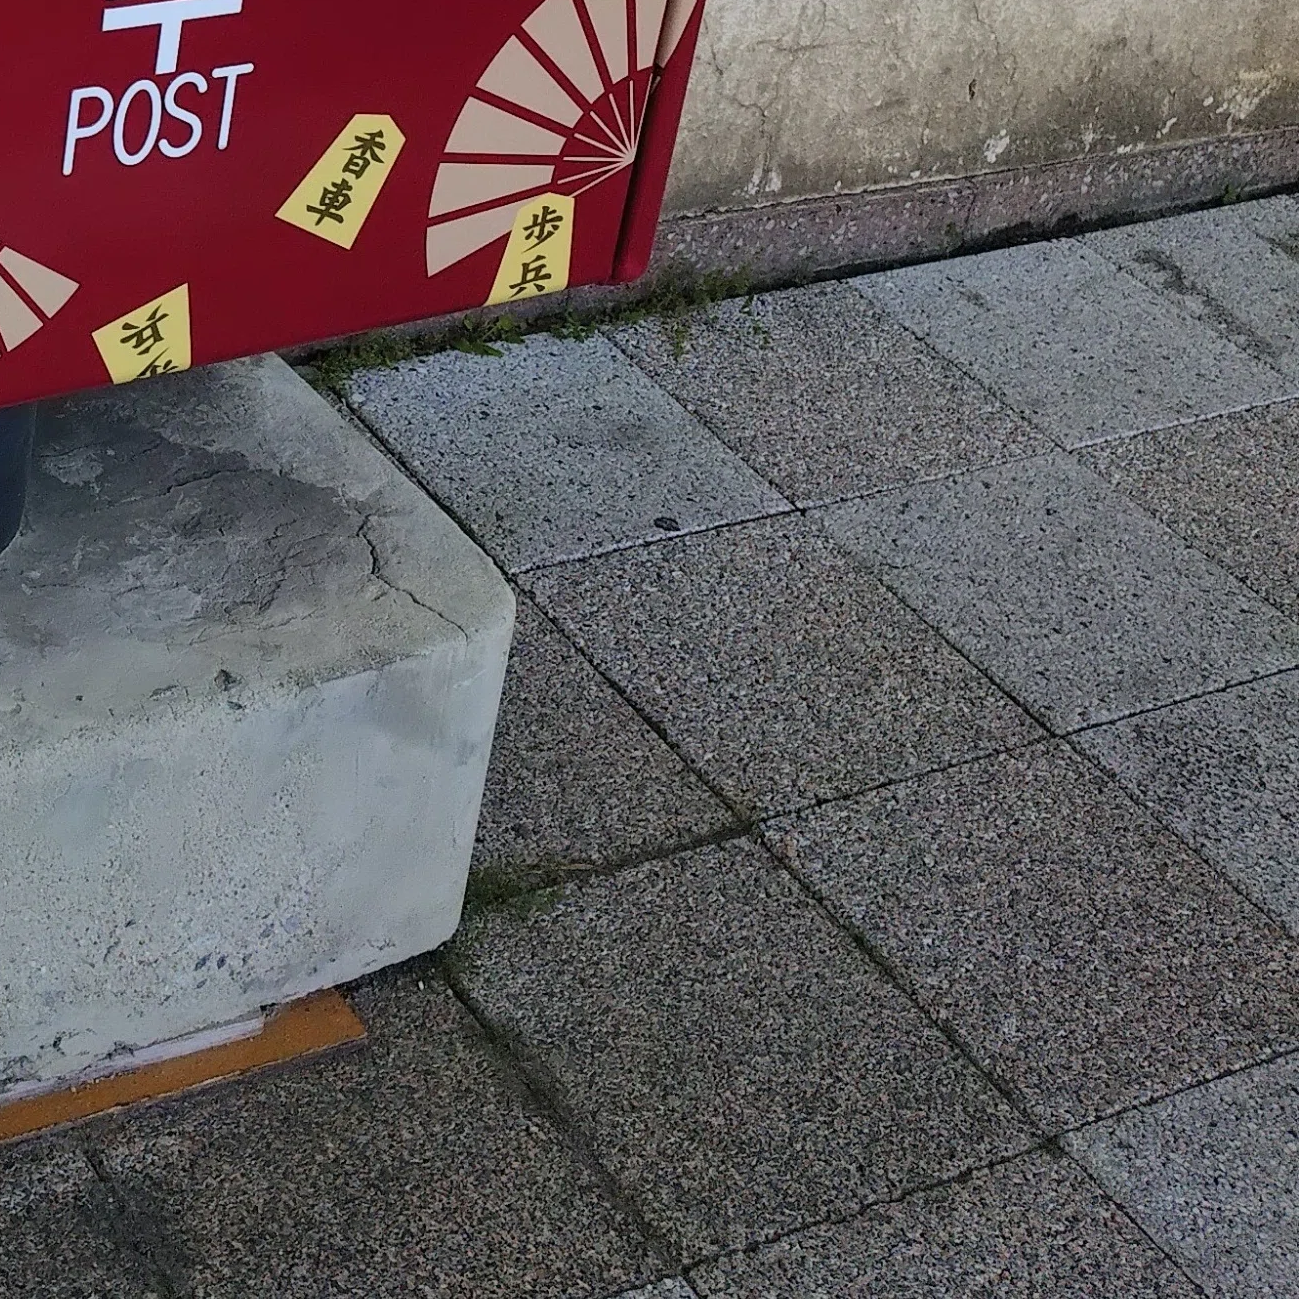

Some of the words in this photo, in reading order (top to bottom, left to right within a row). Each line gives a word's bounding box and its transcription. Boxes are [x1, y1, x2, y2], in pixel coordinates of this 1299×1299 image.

[61, 63, 254, 176] POST
[306, 128, 386, 226] 香車
[508, 205, 564, 298] 歩兵
